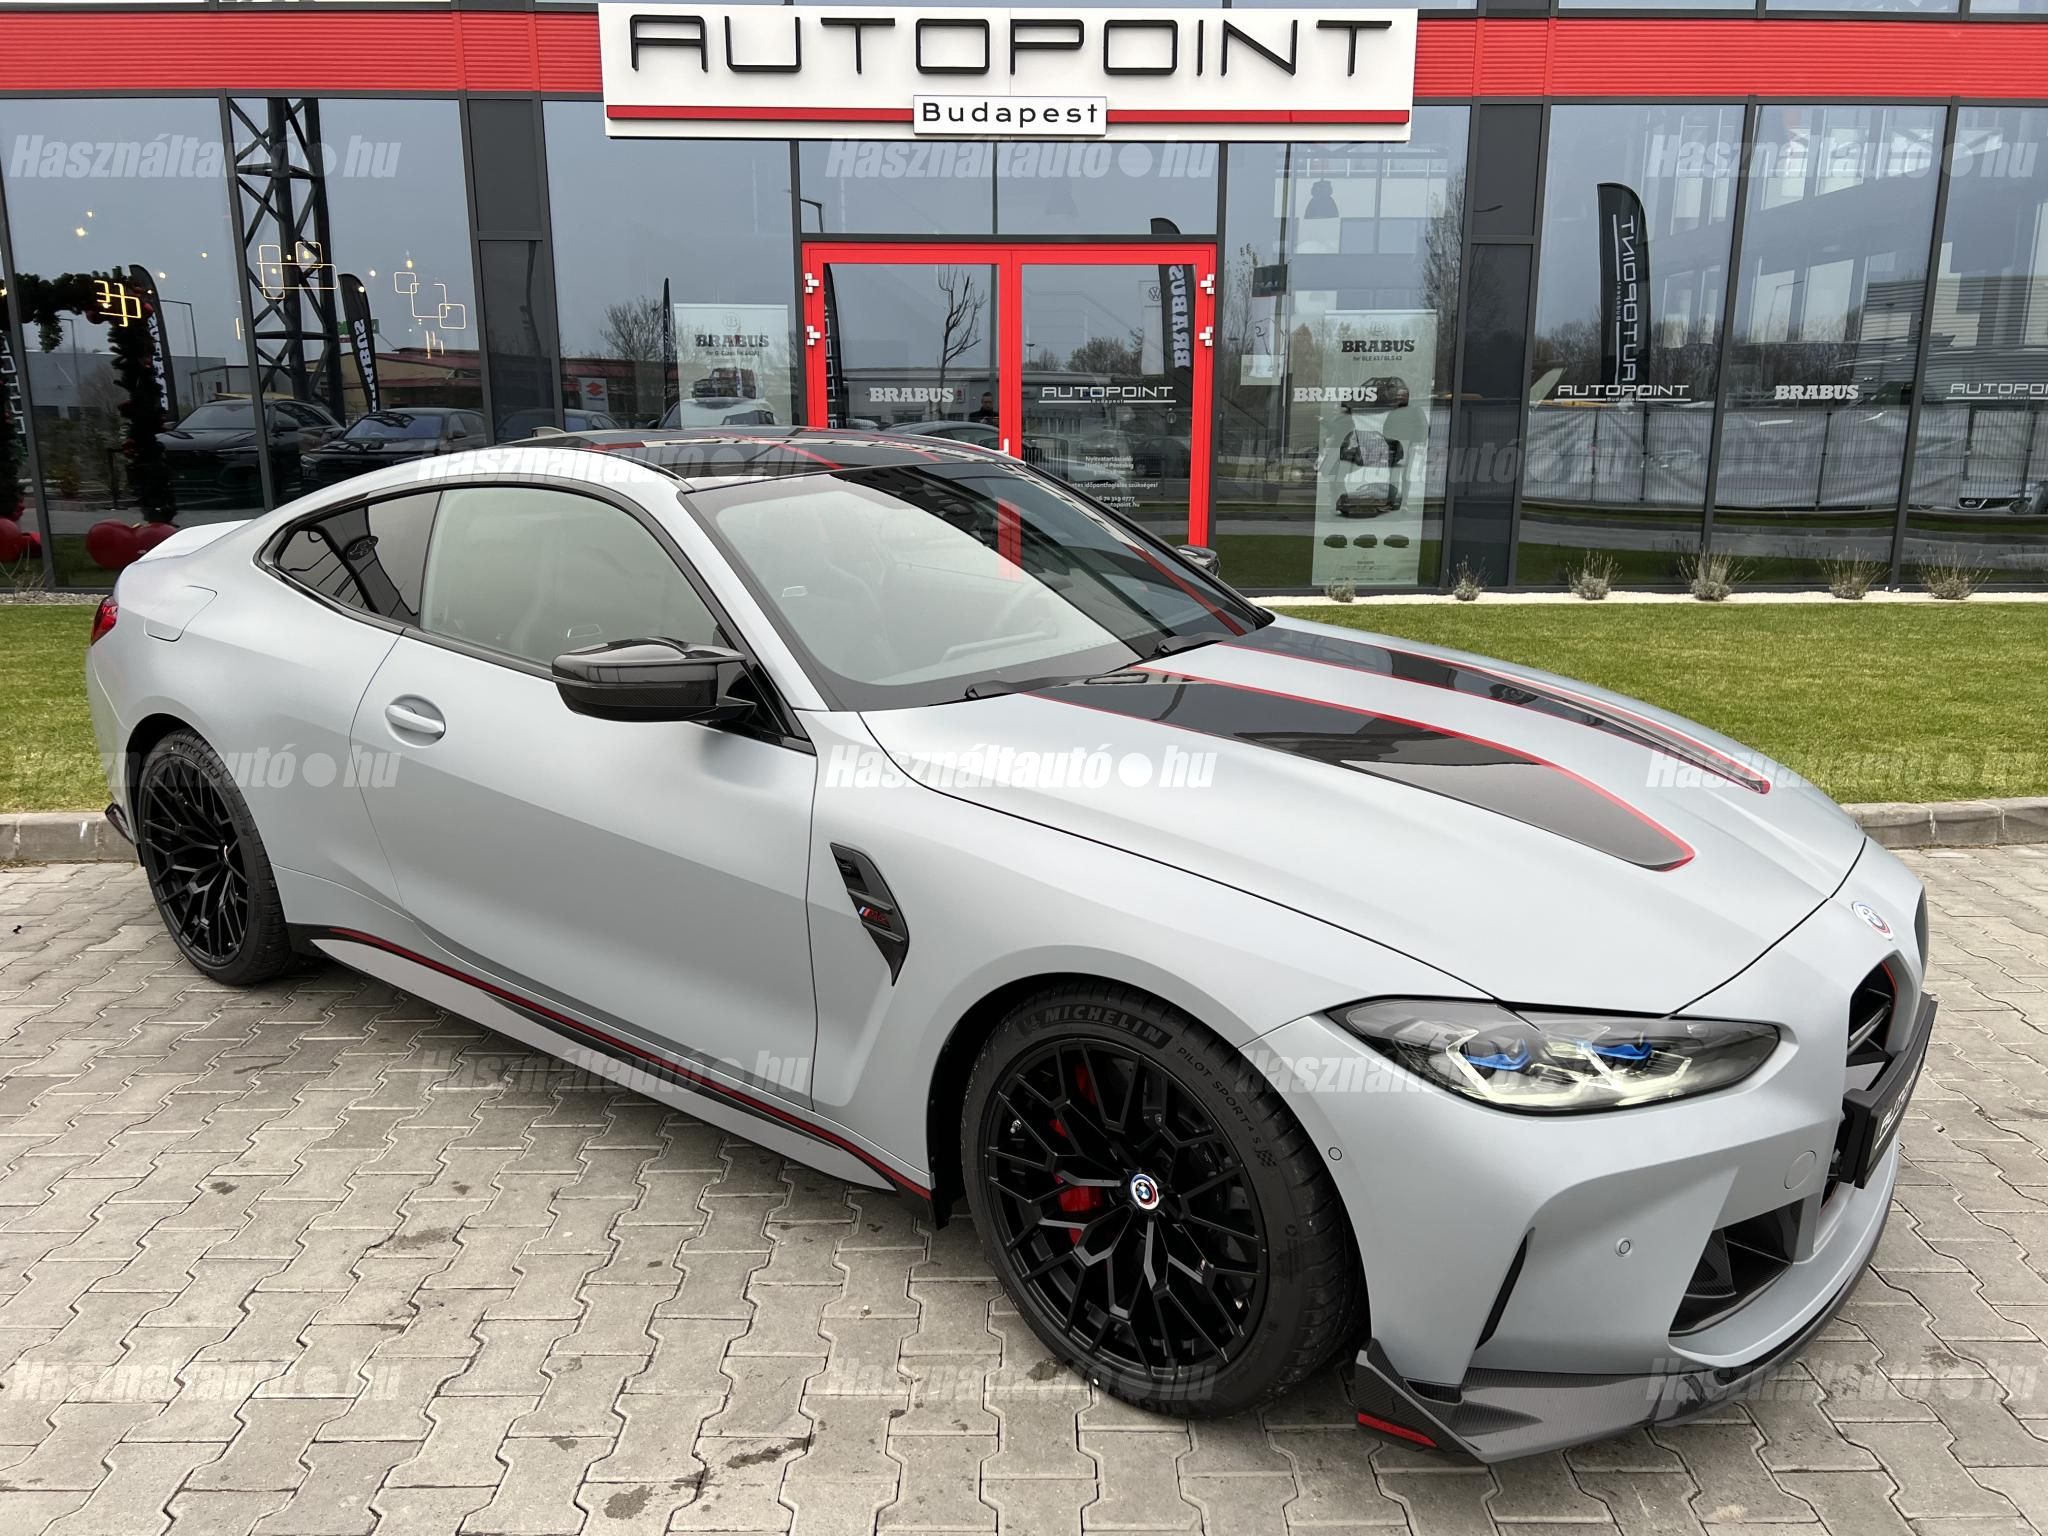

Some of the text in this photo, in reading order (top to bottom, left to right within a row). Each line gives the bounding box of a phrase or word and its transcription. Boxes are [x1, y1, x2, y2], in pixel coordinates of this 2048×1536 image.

[629, 14, 1392, 76] AUTOPOINT
[922, 102, 1098, 128] Budapest
[694, 334, 770, 348] BRABUS
[1341, 340, 1416, 352] BRABUS
[869, 388, 954, 403] BRABUS
[1042, 386, 1173, 398] AUTOPOINT
[1293, 387, 1378, 402] BRABUS
[1557, 385, 1689, 396] AUTOPOINT
[1774, 385, 1859, 400] BRABUS
[1045, 1005, 1163, 1043] MICHELIN
[1177, 1047, 1212, 1077] PILOT
[1212, 1081, 1249, 1123] SPORT
